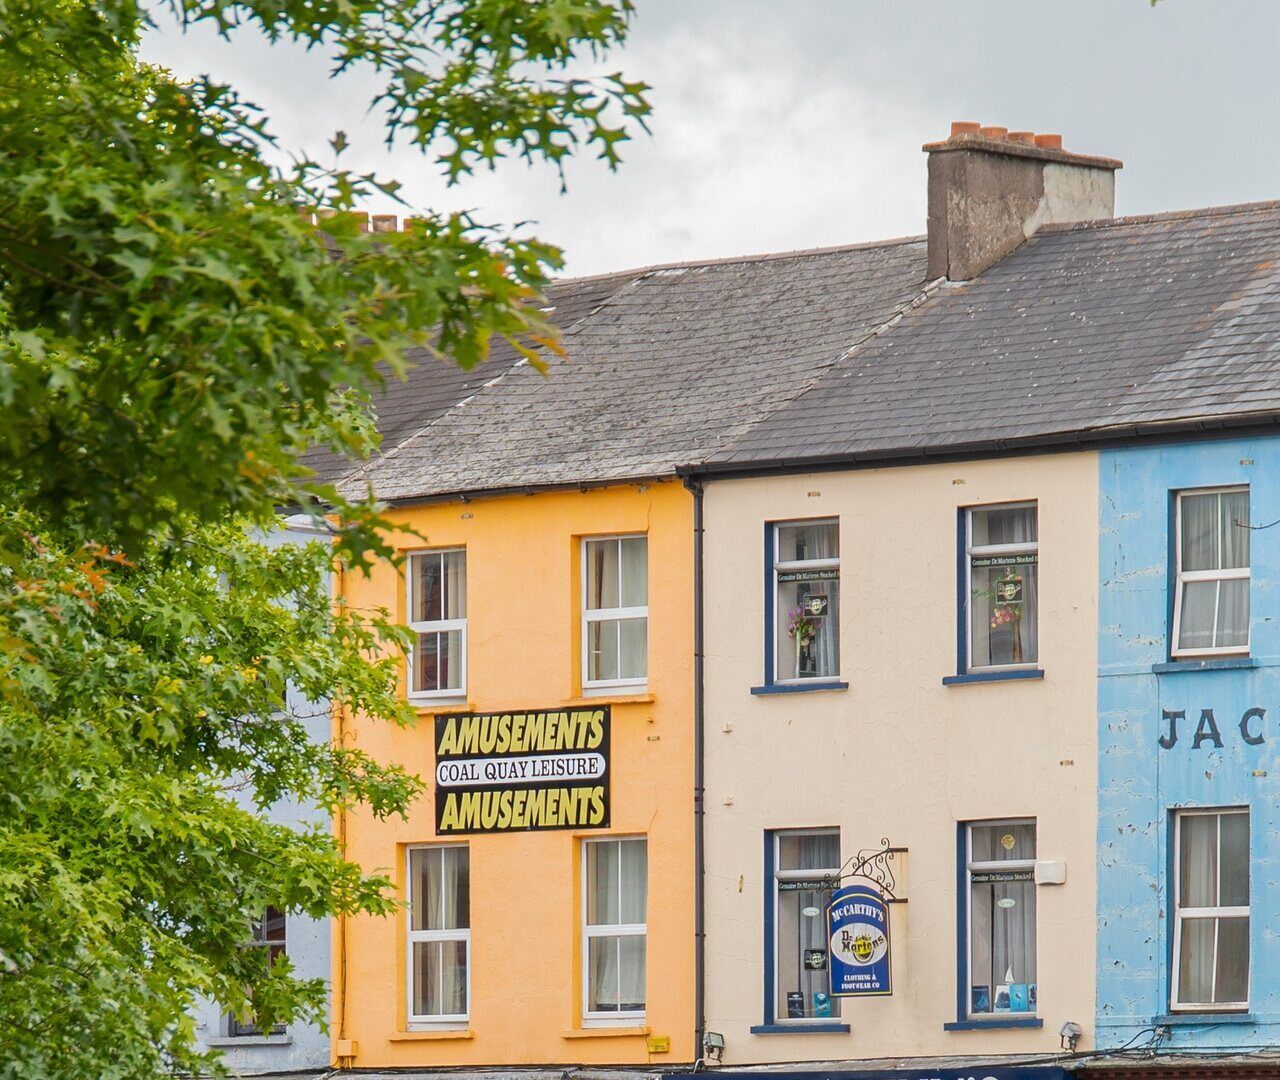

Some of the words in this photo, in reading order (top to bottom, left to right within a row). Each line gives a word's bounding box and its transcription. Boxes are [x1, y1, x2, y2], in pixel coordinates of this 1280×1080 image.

[437, 710, 604, 756] AMUSEMENTS
[439, 763, 480, 782] COAL
[484, 760, 528, 780] QUAY
[531, 757, 599, 777] LEISURE
[439, 785, 605, 830] AMUSEMENTS
[832, 904, 885, 922] McCARTHY'S
[841, 935, 884, 953] Martens
[841, 982, 871, 990] FOOTWEAR
